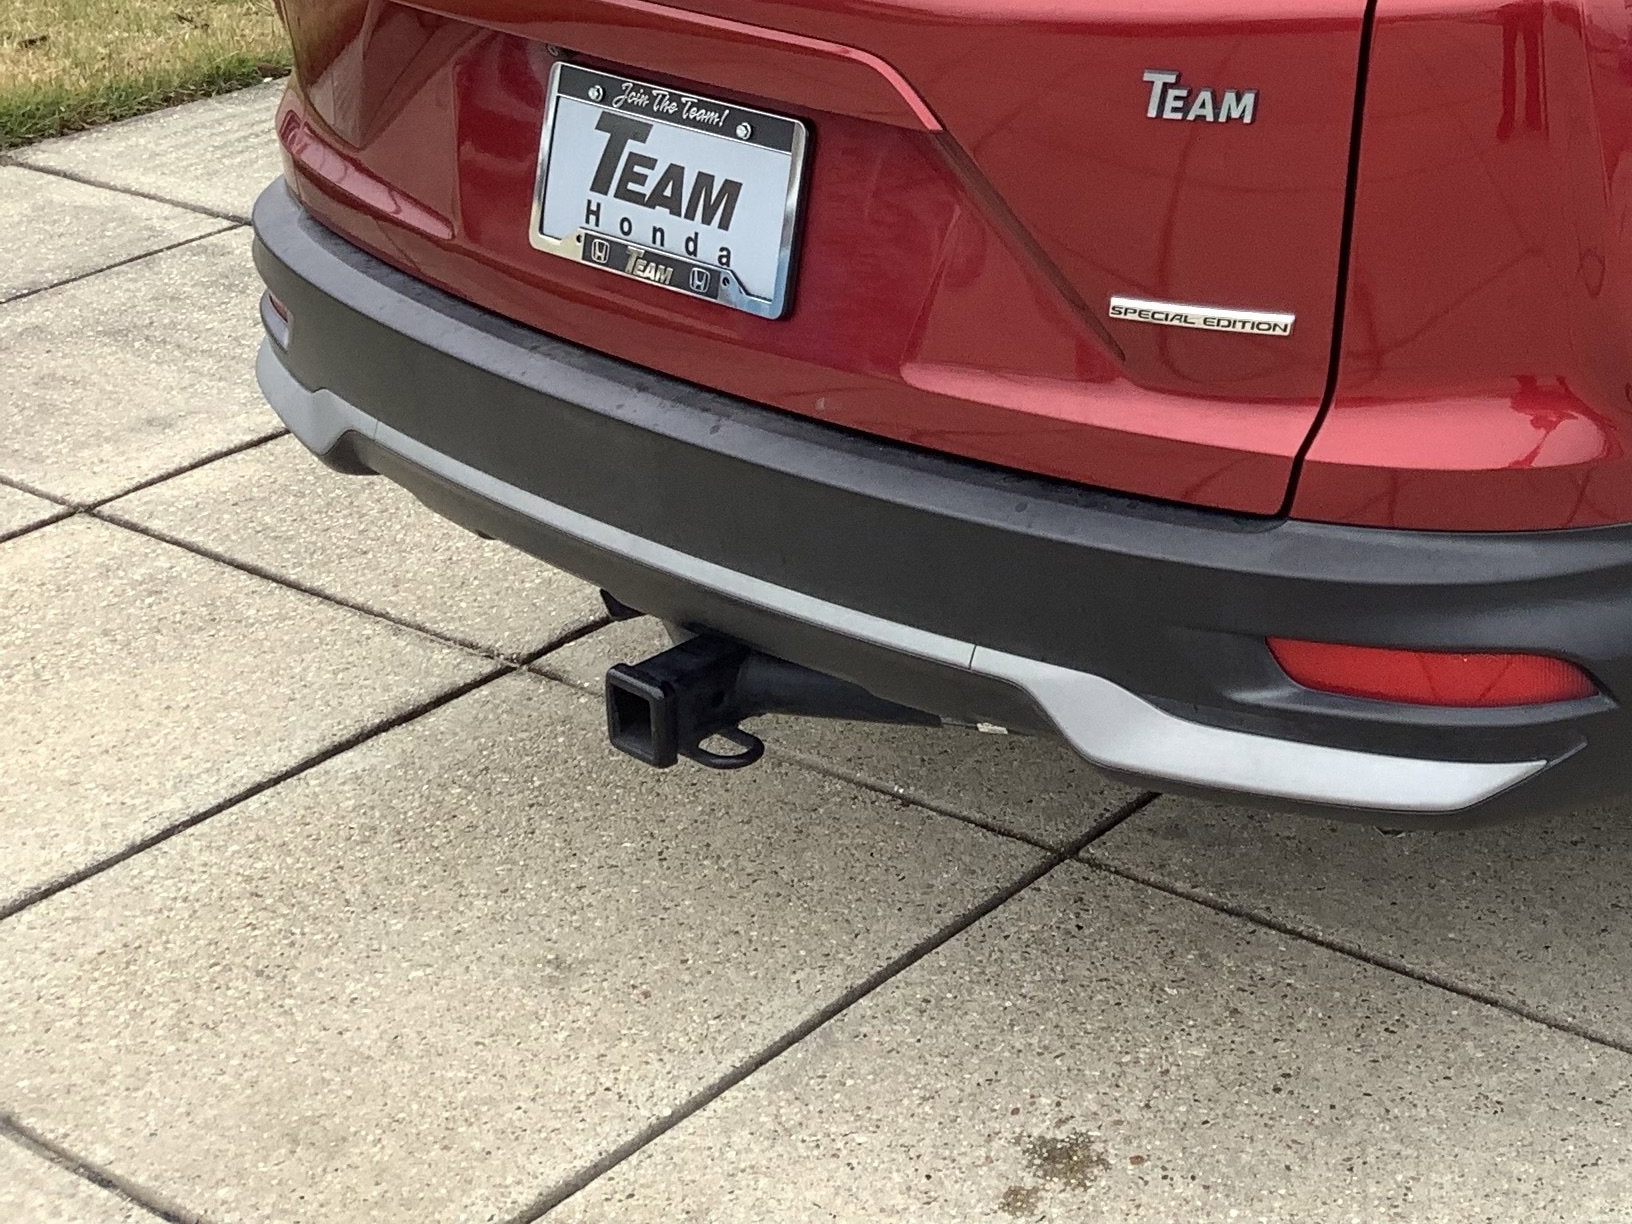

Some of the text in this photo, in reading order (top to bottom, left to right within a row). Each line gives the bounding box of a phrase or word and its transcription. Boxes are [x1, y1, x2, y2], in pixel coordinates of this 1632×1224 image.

[611, 82, 731, 128] Join The Team!
[1142, 69, 1259, 125] TEAM
[588, 110, 744, 232] TEAM
[584, 198, 733, 268] Honda
[624, 245, 674, 286] TEAM
[1109, 304, 1290, 334] SPECIAL EDITION
